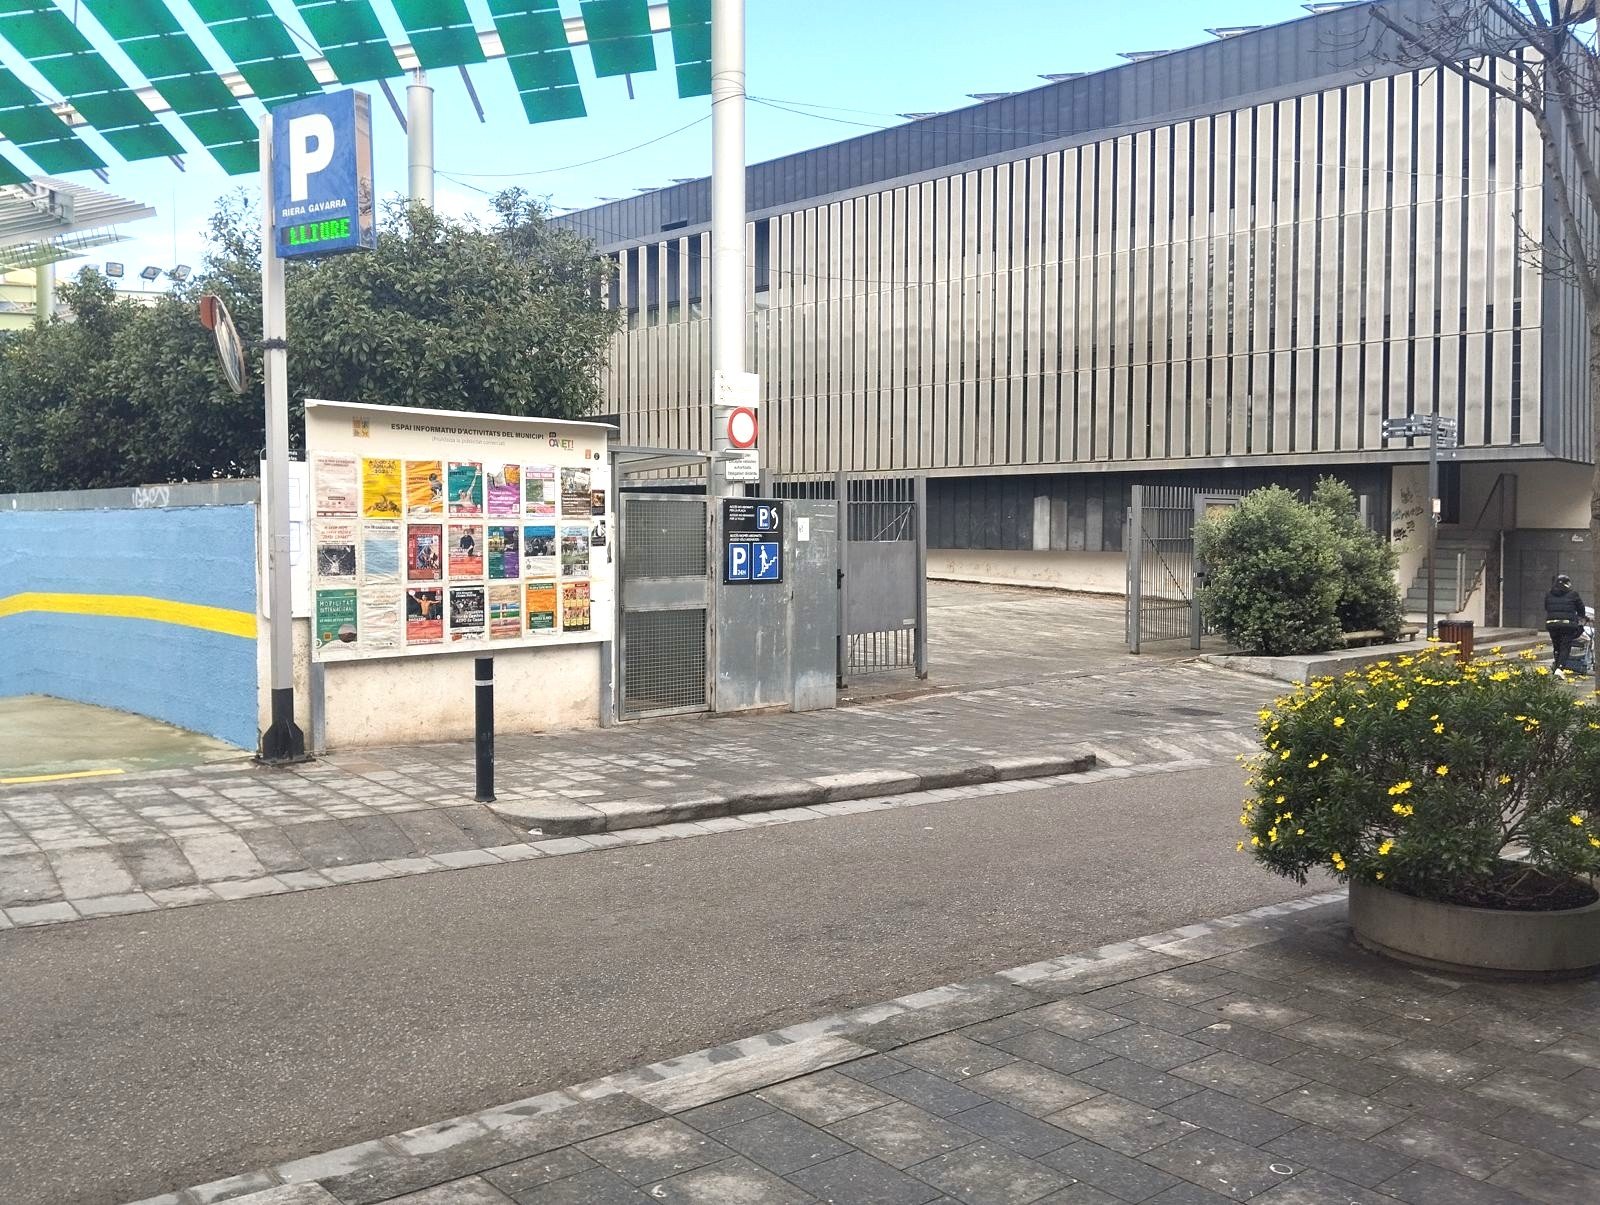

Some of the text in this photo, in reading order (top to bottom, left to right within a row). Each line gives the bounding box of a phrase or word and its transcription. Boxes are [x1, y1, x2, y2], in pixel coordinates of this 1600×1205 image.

[289, 113, 335, 202] P
[282, 198, 347, 217] RIERA GAVARRA
[391, 423, 412, 431] ESPAI
[413, 424, 456, 434] INFORMATIU
[457, 427, 501, 438] D'ACTIVITATS
[515, 432, 544, 440] MUNICIPI
[759, 508, 768, 527] P
[733, 547, 746, 576] P
